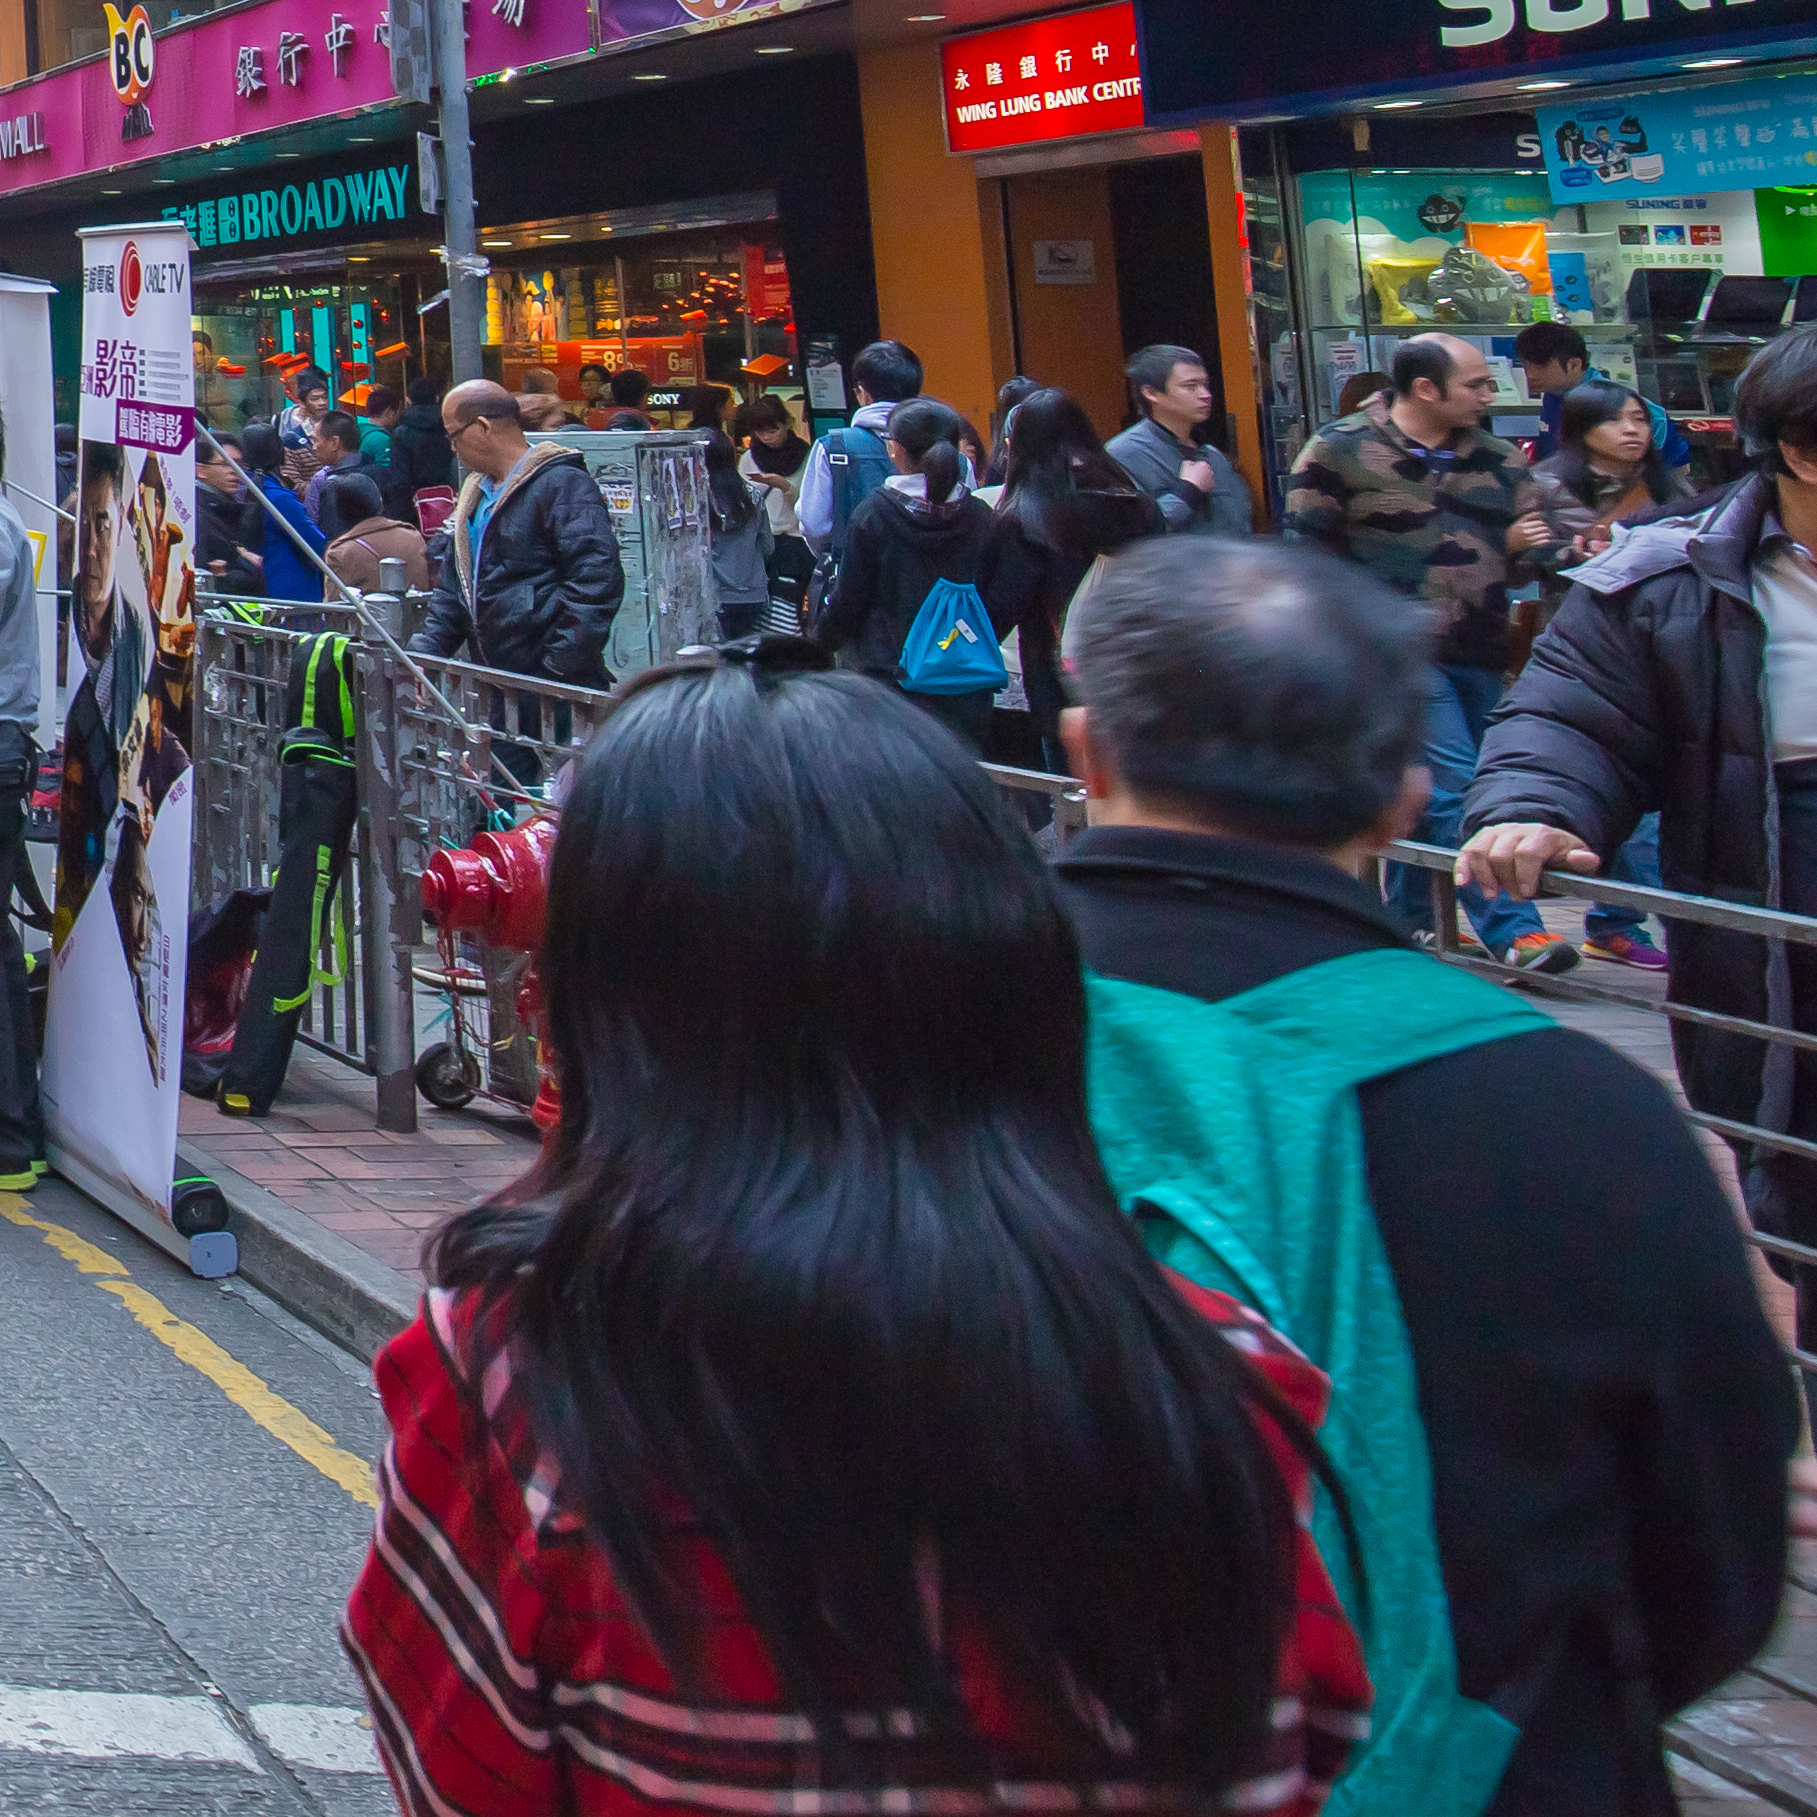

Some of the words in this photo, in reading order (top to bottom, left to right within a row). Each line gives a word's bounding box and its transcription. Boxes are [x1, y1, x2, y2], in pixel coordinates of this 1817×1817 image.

[112, 28, 153, 93] BC
[956, 98, 997, 124] WING
[1000, 93, 1041, 118] LUNG
[1044, 88, 1088, 111] BANK
[243, 163, 410, 243] BROADWAY
[168, 263, 185, 294] TV
